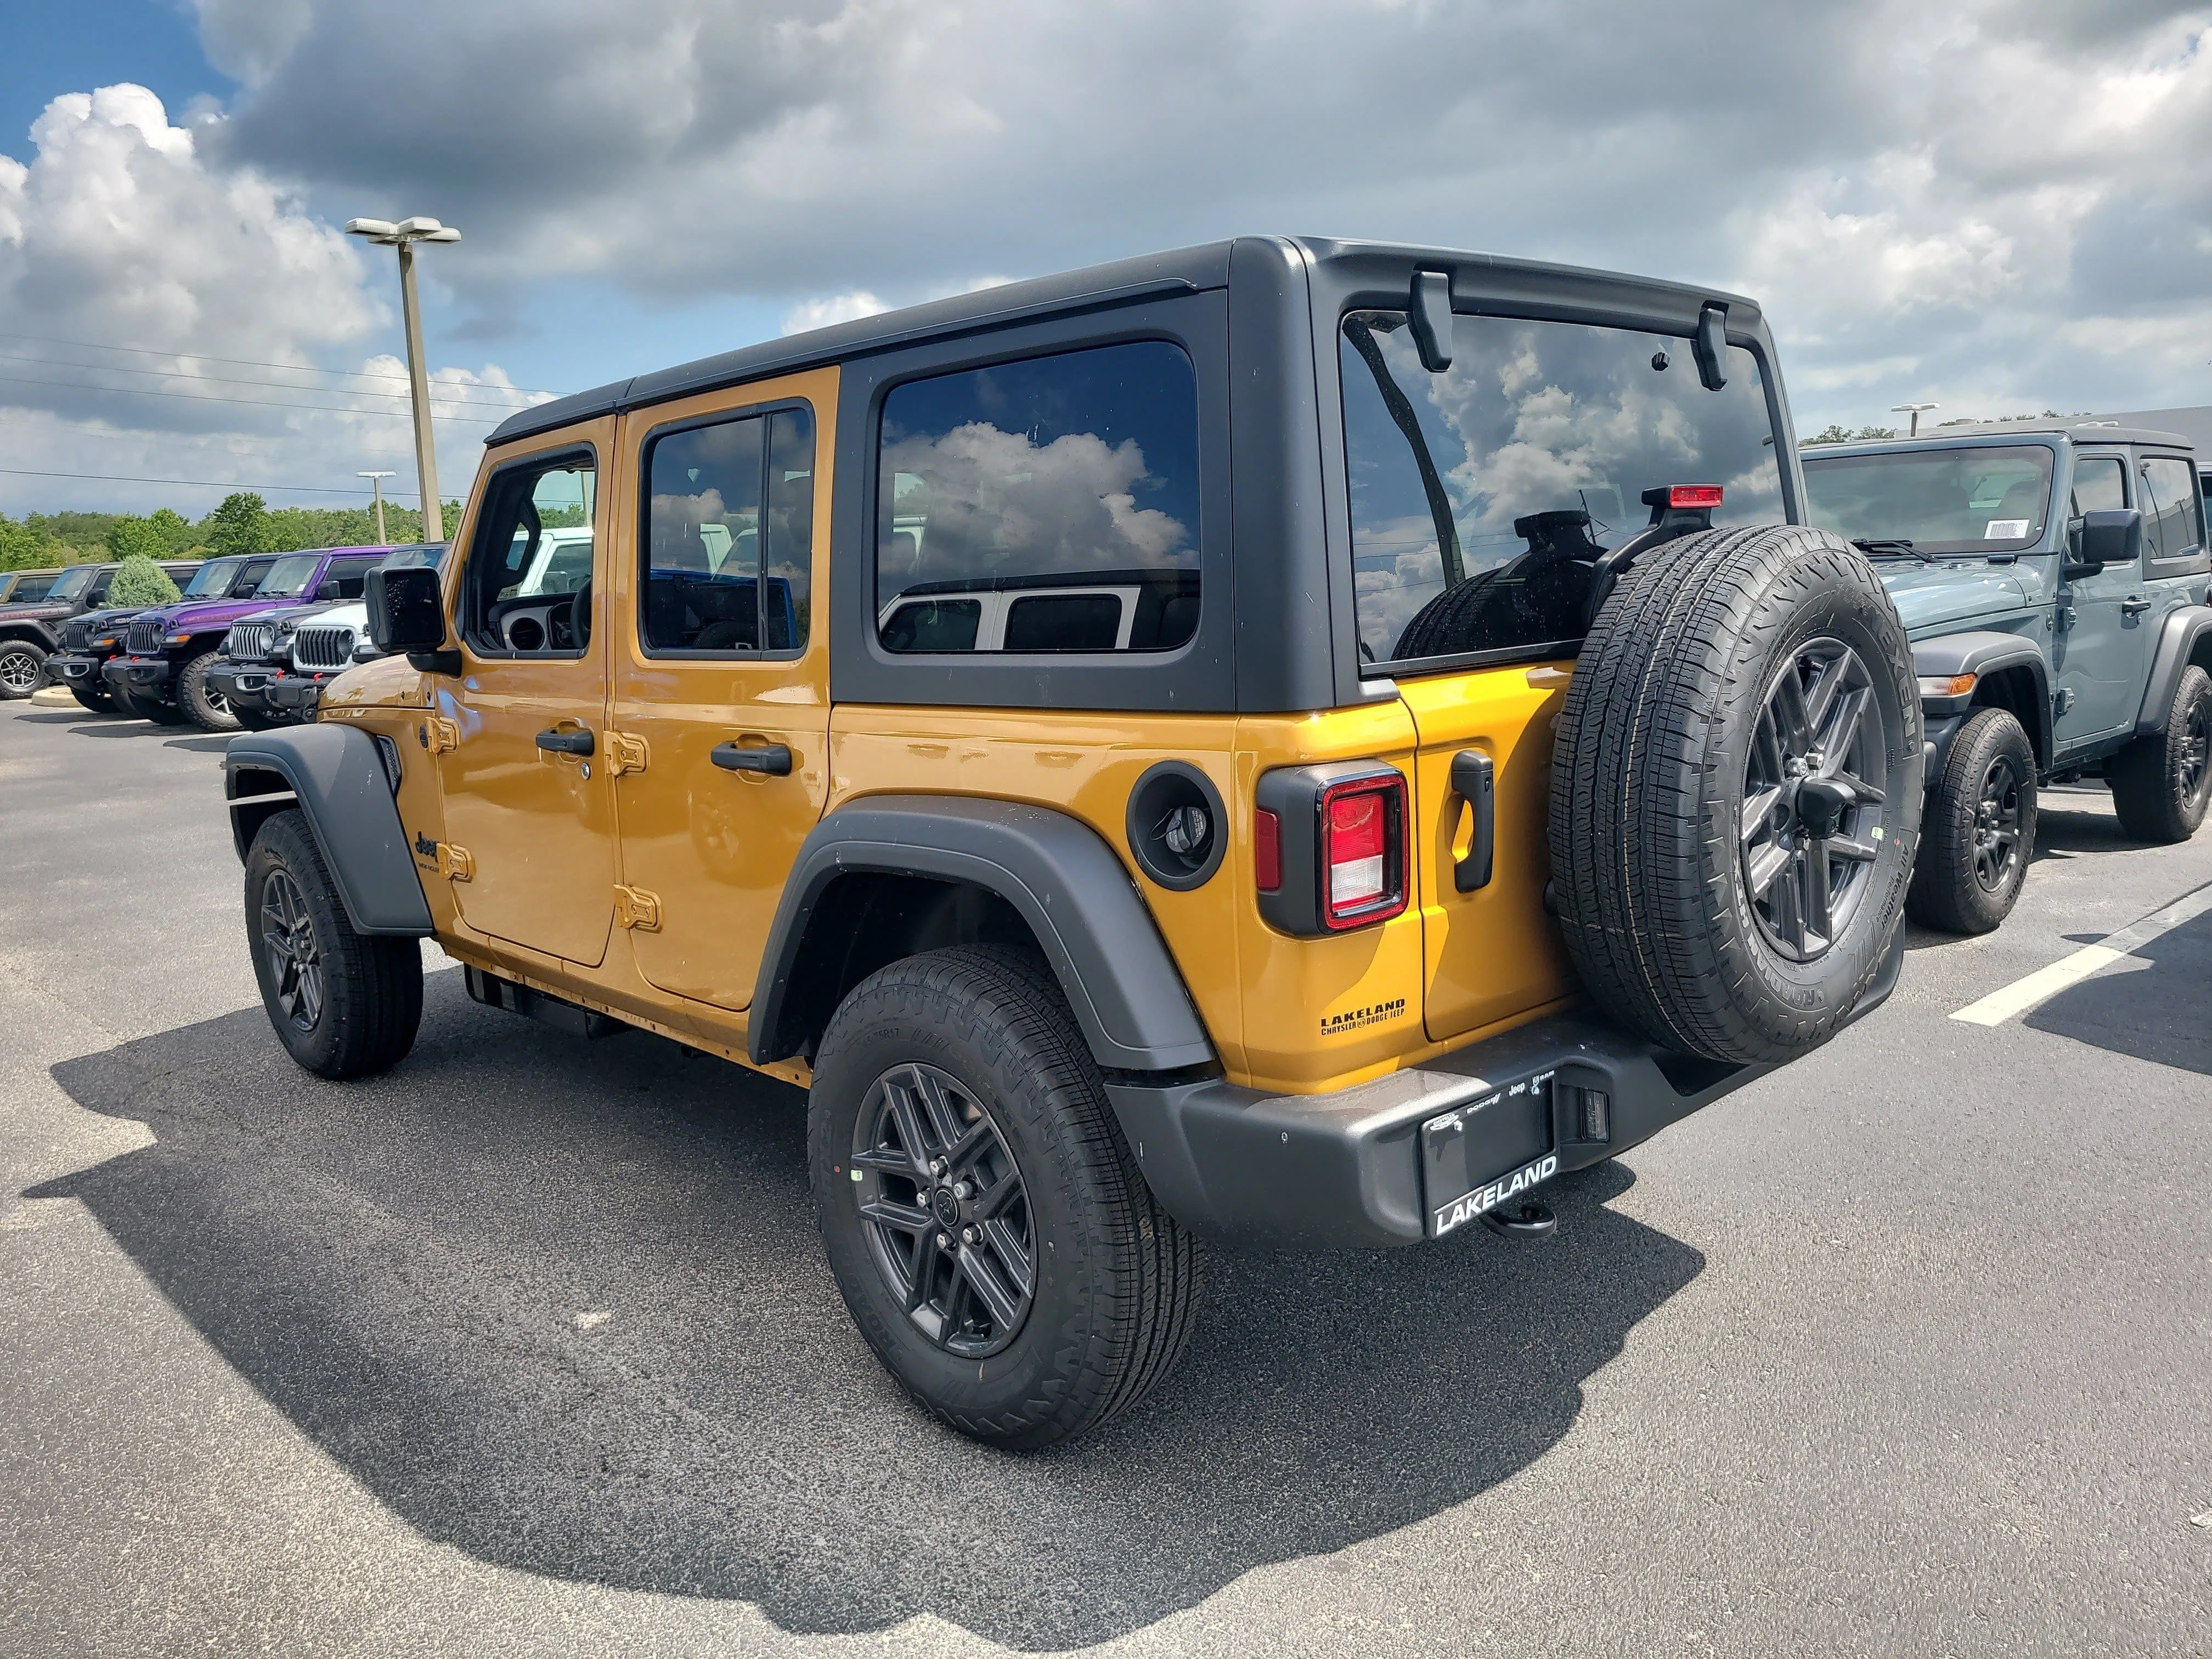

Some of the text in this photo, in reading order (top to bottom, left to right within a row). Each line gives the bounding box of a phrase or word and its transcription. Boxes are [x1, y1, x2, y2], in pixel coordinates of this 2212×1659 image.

[1876, 876, 1894, 923] Performance
[1321, 998, 1405, 1027] LAKELAND
[1321, 1008, 1404, 1036] CHRYSLER DODGE JEEP
[1433, 1070, 1555, 1126] CHRYSLER DODGE Jeep RAM
[1436, 1155, 1557, 1236] LAKELAND
